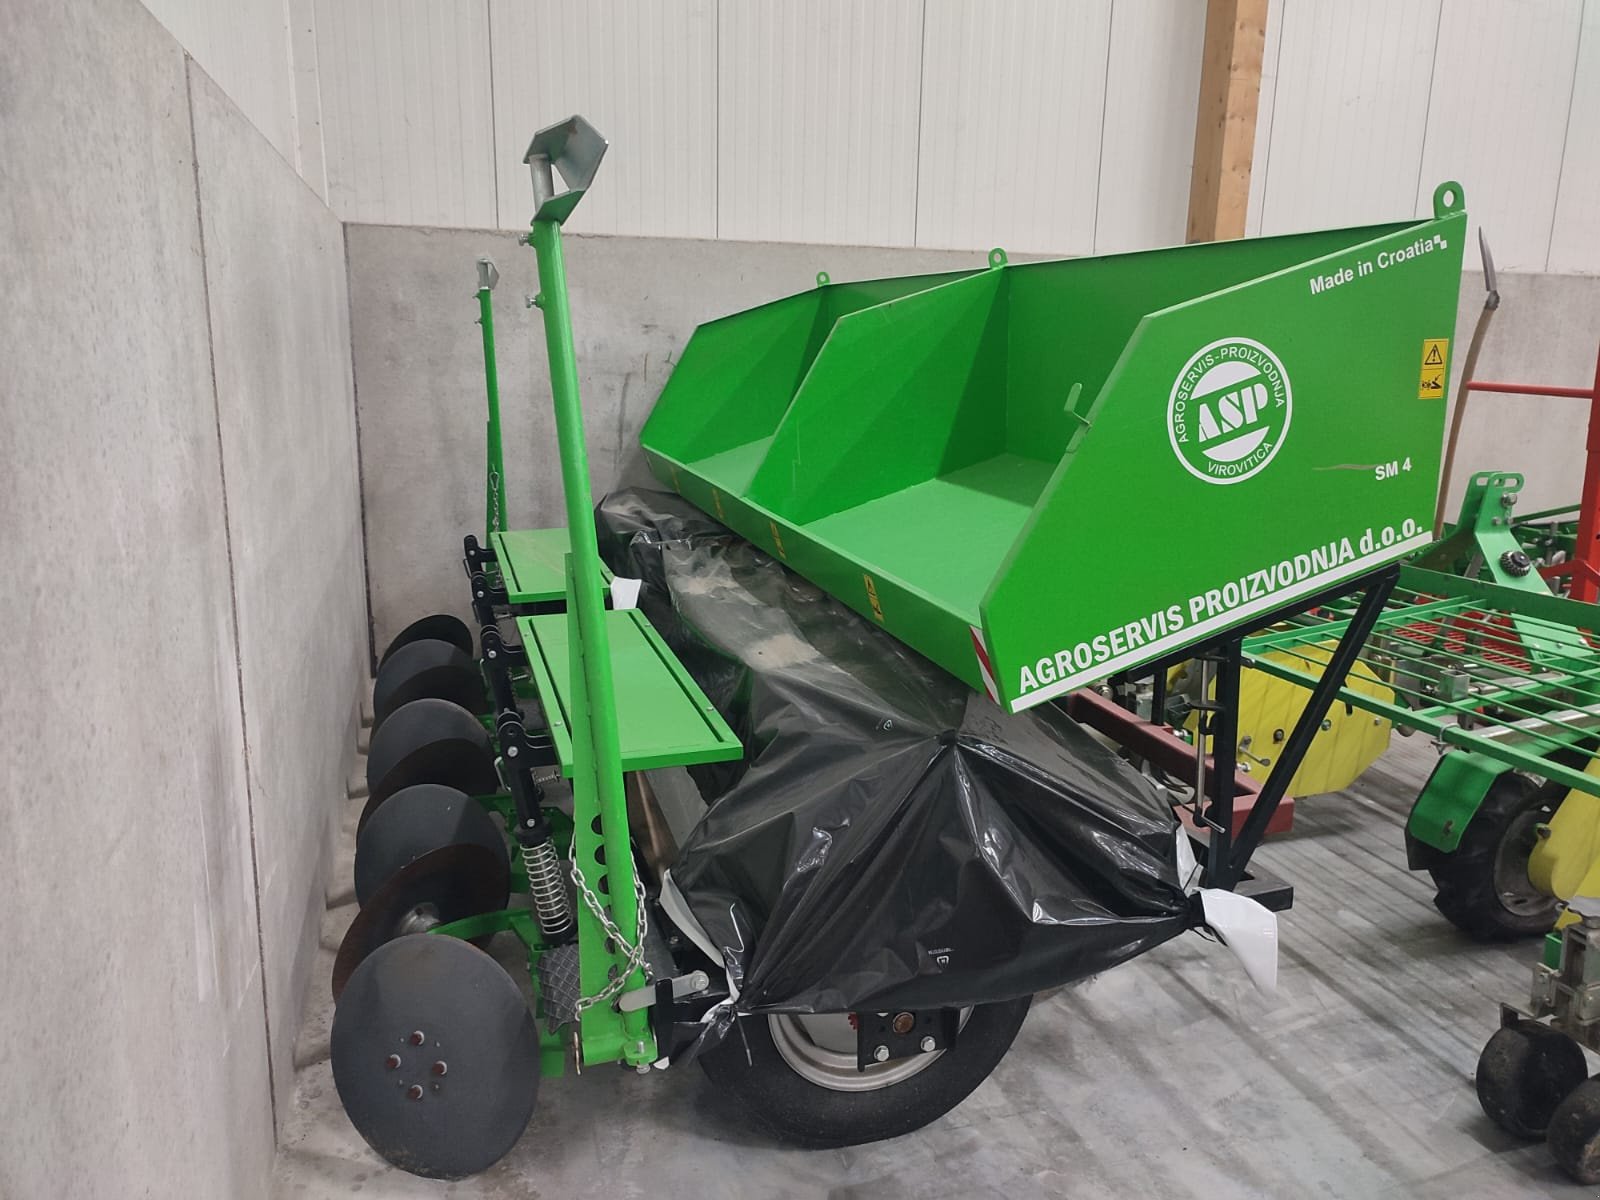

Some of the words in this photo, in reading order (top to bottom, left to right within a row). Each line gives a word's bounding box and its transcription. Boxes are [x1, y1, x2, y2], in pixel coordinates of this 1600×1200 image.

[1309, 268, 1354, 295] Made
[1358, 261, 1374, 277] in
[1377, 238, 1434, 269] Croatia
[1198, 383, 1269, 443] ASP
[1207, 441, 1273, 476] VIROVITICA
[1375, 461, 1399, 481] SM
[1402, 457, 1413, 471] 4
[1019, 605, 1184, 694] AGROSERVIS
[1190, 537, 1355, 623] PROIZVODNJA
[1358, 517, 1423, 555] d.o.o.
